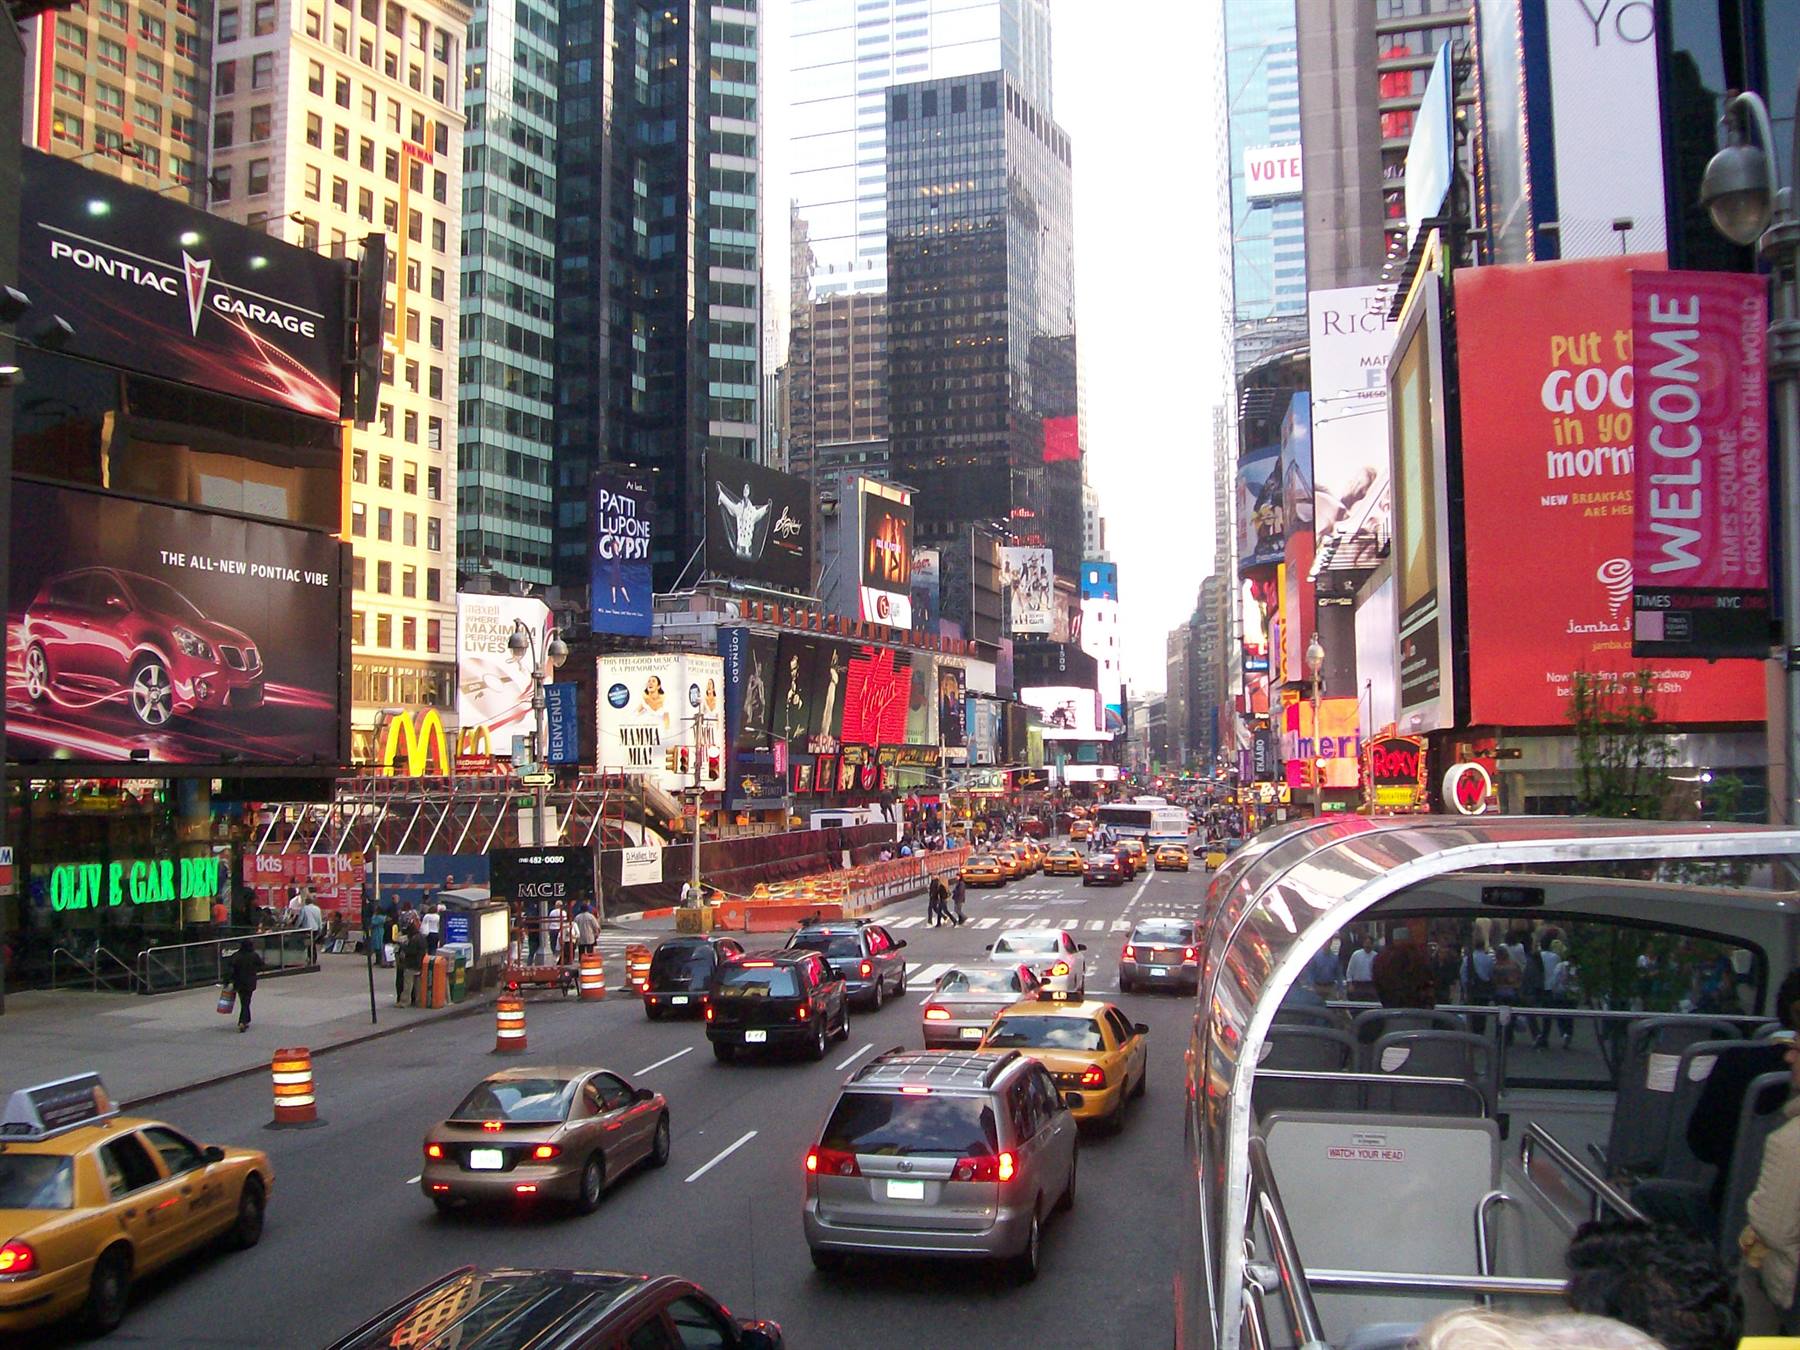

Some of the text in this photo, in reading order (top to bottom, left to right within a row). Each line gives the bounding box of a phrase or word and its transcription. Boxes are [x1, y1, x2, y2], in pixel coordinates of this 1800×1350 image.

[1250, 158, 1300, 181] VOTE
[50, 240, 178, 296] PONTIAC
[212, 293, 316, 338] GARAGE
[1554, 418, 1584, 446] in
[1649, 293, 1702, 574] WELCOME
[600, 489, 635, 517] PATTI
[1541, 495, 1568, 507] NEW
[1584, 506, 1611, 517] ARE
[599, 534, 650, 560] GYPSY
[160, 551, 329, 587] THE ALL-NEW PONTIAC VIBE
[1634, 594, 1672, 608] TIMES
[1716, 596, 1742, 608] NYC
[464, 641, 506, 653] LIVES
[1546, 672, 1568, 683] Now
[1657, 682, 1681, 693] 48th
[552, 688, 564, 761] BIENVENUE
[619, 727, 660, 746] MAMMA
[628, 747, 652, 765] MIA!
[256, 854, 282, 873] tkts
[517, 882, 566, 898] MCE
[1329, 1148, 1403, 1160] WATCH YOUR HEAD
